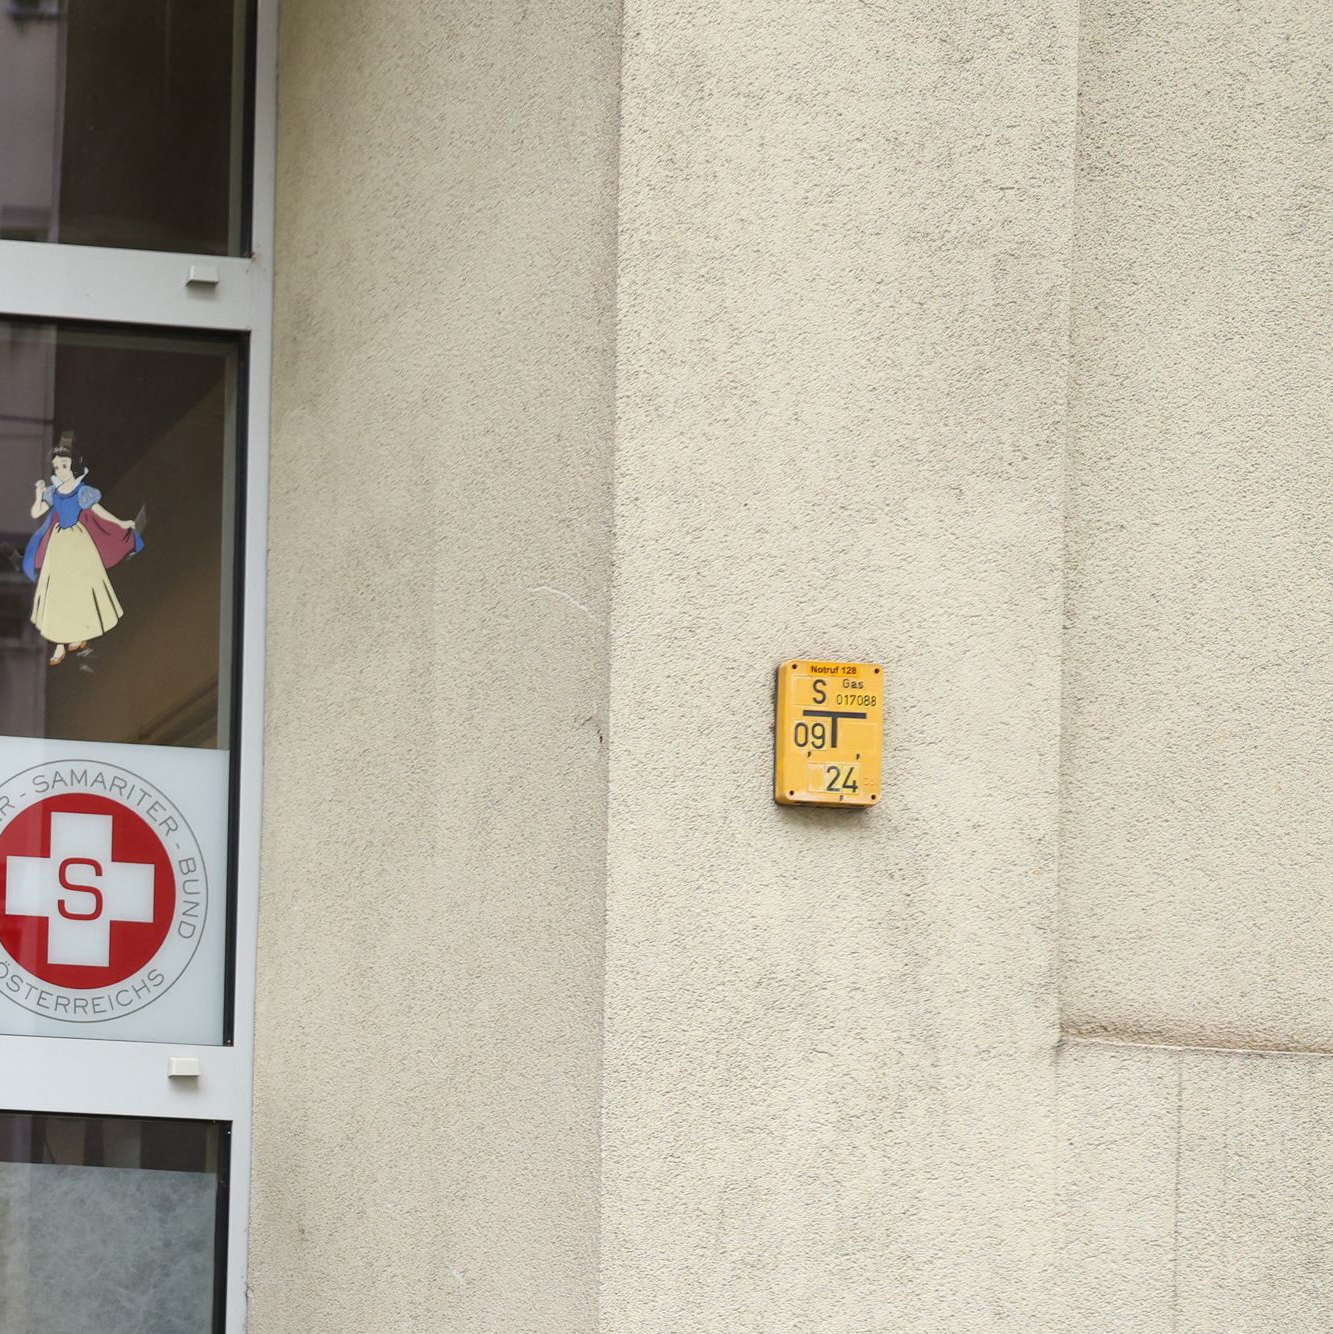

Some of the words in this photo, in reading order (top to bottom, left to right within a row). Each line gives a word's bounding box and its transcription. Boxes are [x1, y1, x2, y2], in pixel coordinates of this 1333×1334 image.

[810, 665, 839, 674] Notruf
[812, 679, 827, 704] S
[842, 679, 864, 690] Gas
[794, 722, 826, 749] 09
[826, 766, 858, 793] 24
[32, 768, 179, 837] SAMARITER
[177, 856, 201, 939] BUND
[57, 857, 103, 921] S
